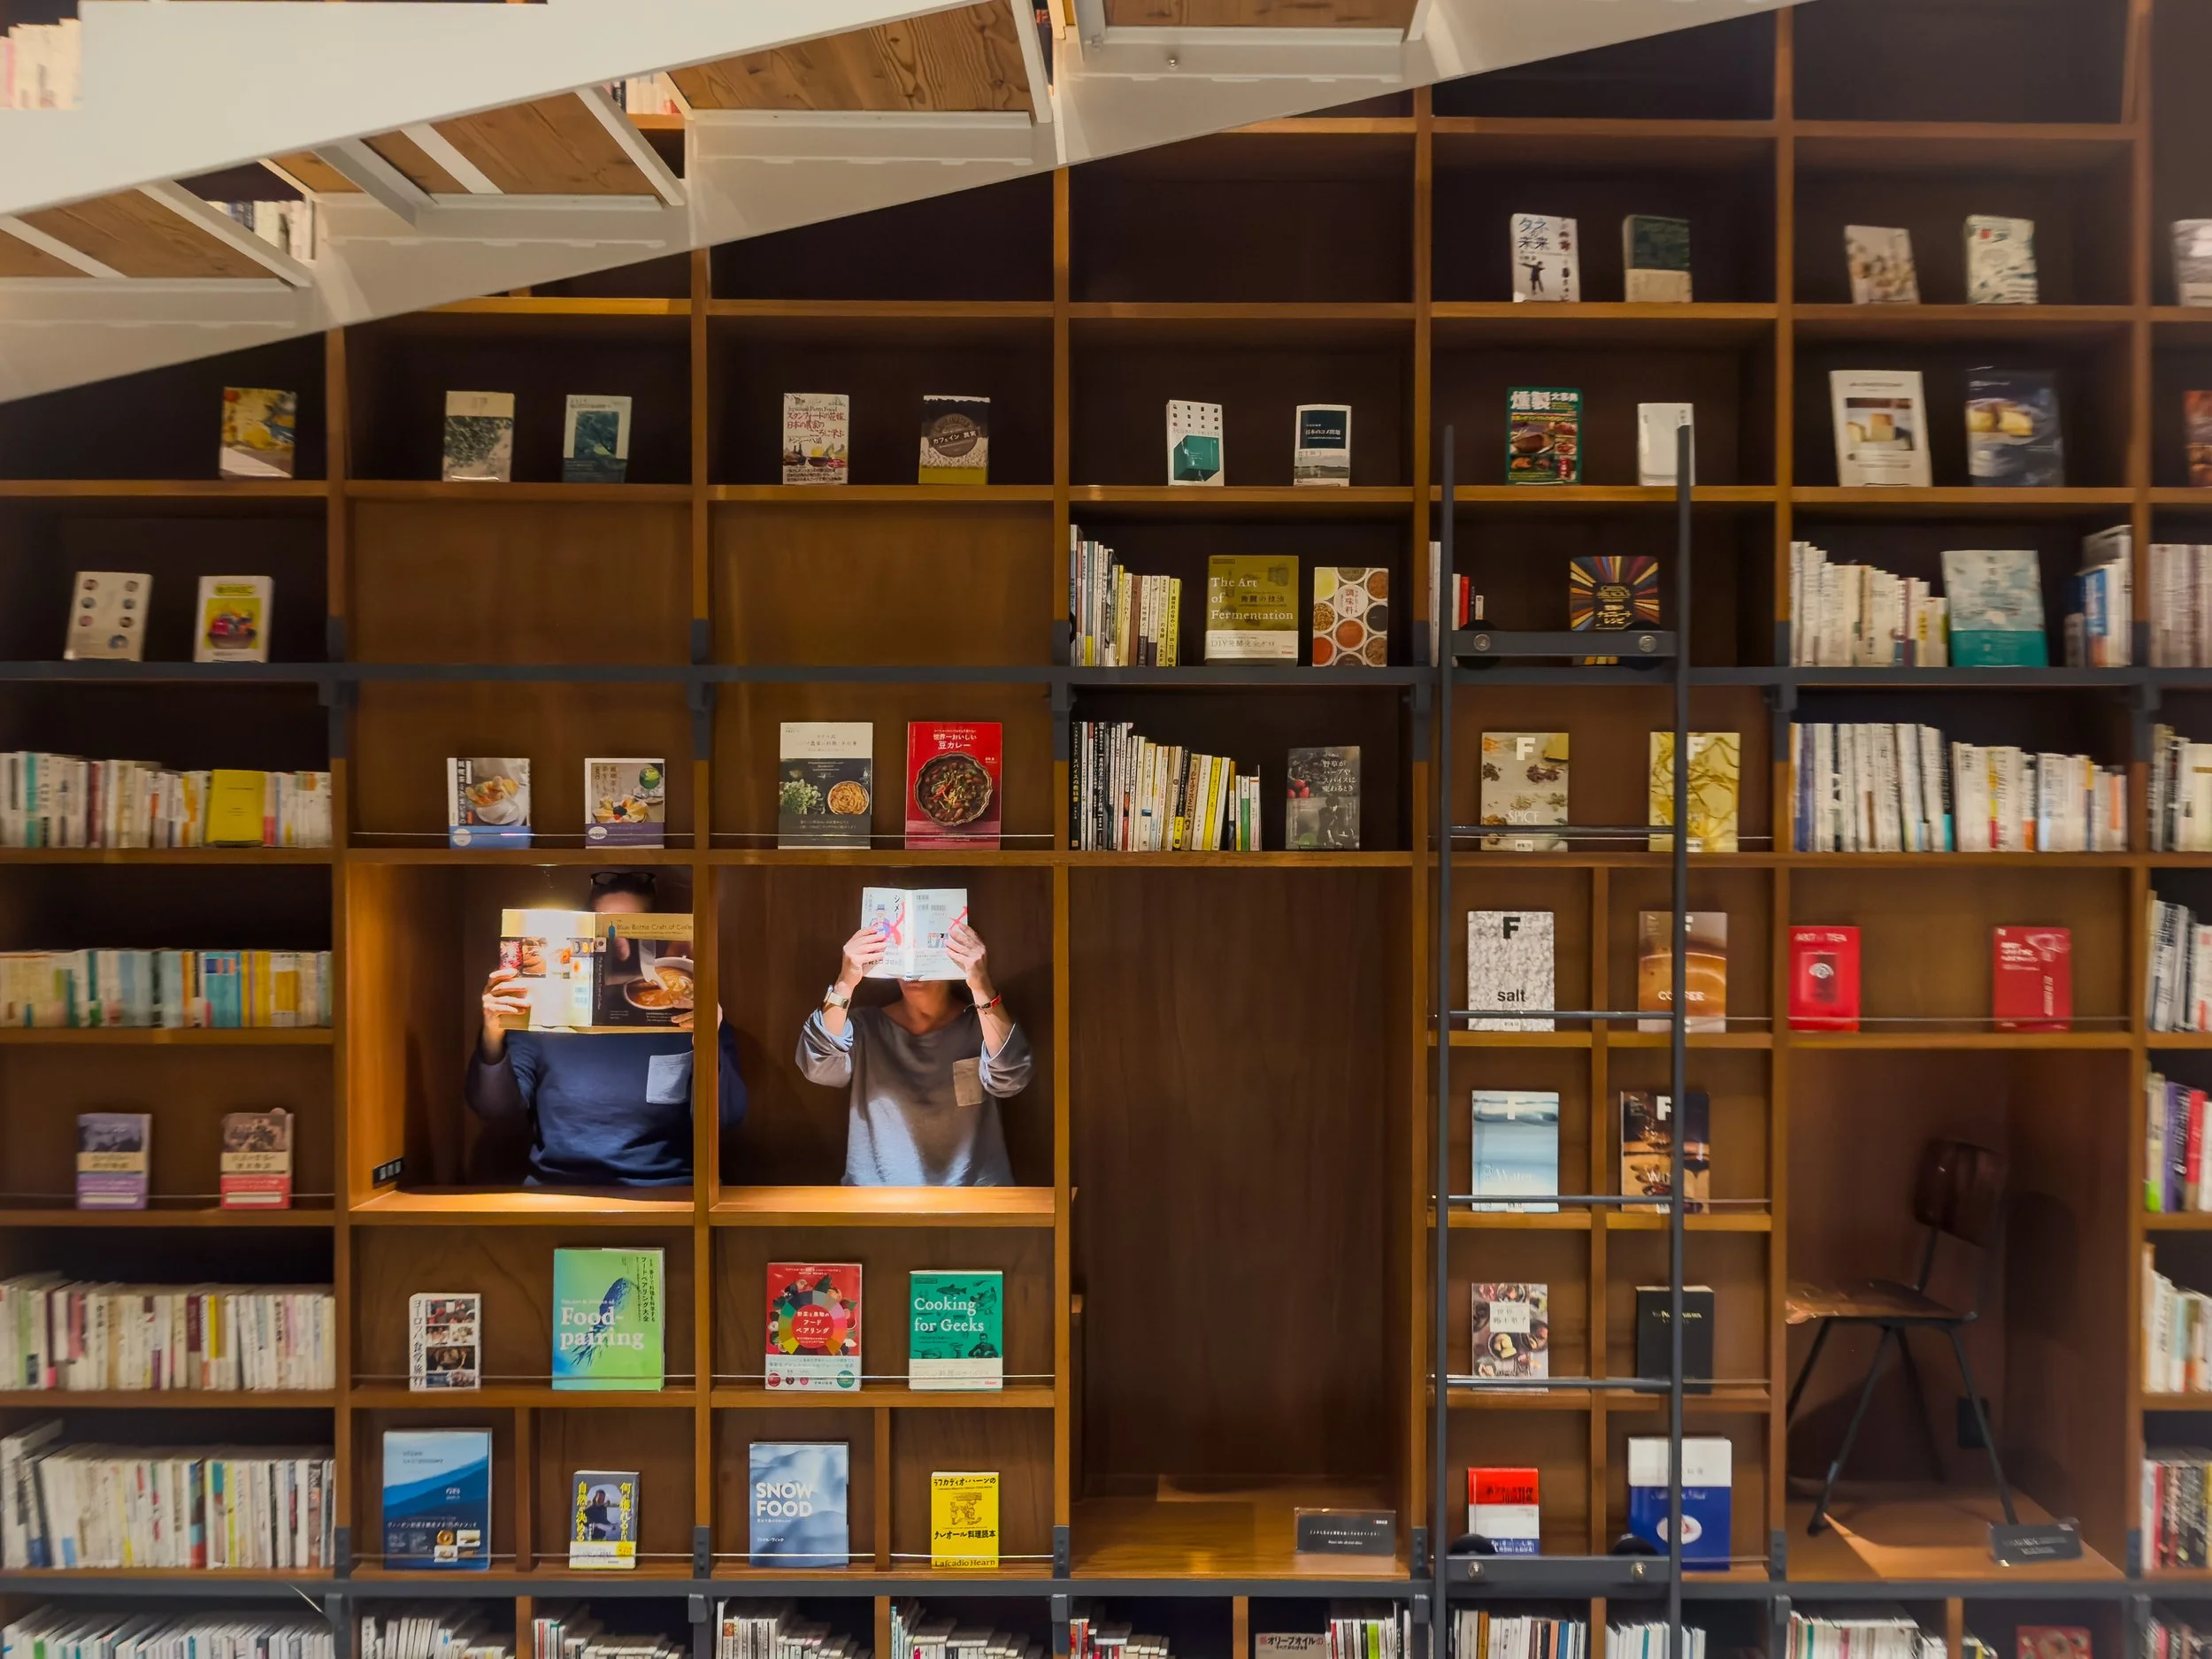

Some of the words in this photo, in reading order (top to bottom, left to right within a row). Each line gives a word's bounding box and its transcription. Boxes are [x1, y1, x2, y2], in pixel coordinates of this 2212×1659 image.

[1210, 577, 1235, 588] The
[1239, 577, 1257, 588] Art
[1211, 592, 1226, 603] of
[1211, 610, 1294, 620] Fermentation
[938, 741, 971, 749] 豆カレー
[1516, 737, 1535, 760] F
[1686, 737, 1706, 760] F
[1507, 811, 1540, 824] SPICE
[1503, 917, 1520, 939] F
[1497, 989, 1526, 1002] salt
[1507, 1096, 1525, 1119] F
[1656, 1095, 1671, 1121] F
[561, 1305, 624, 1325] Food-
[914, 1296, 977, 1317] Cooking
[914, 1317, 937, 1332] for
[940, 1317, 985, 1332] Geeks
[560, 1326, 644, 1350] pairing
[756, 1482, 813, 1499] SNOW
[757, 1500, 813, 1517] FOOD
[934, 1559, 969, 1568] Lafcadio
